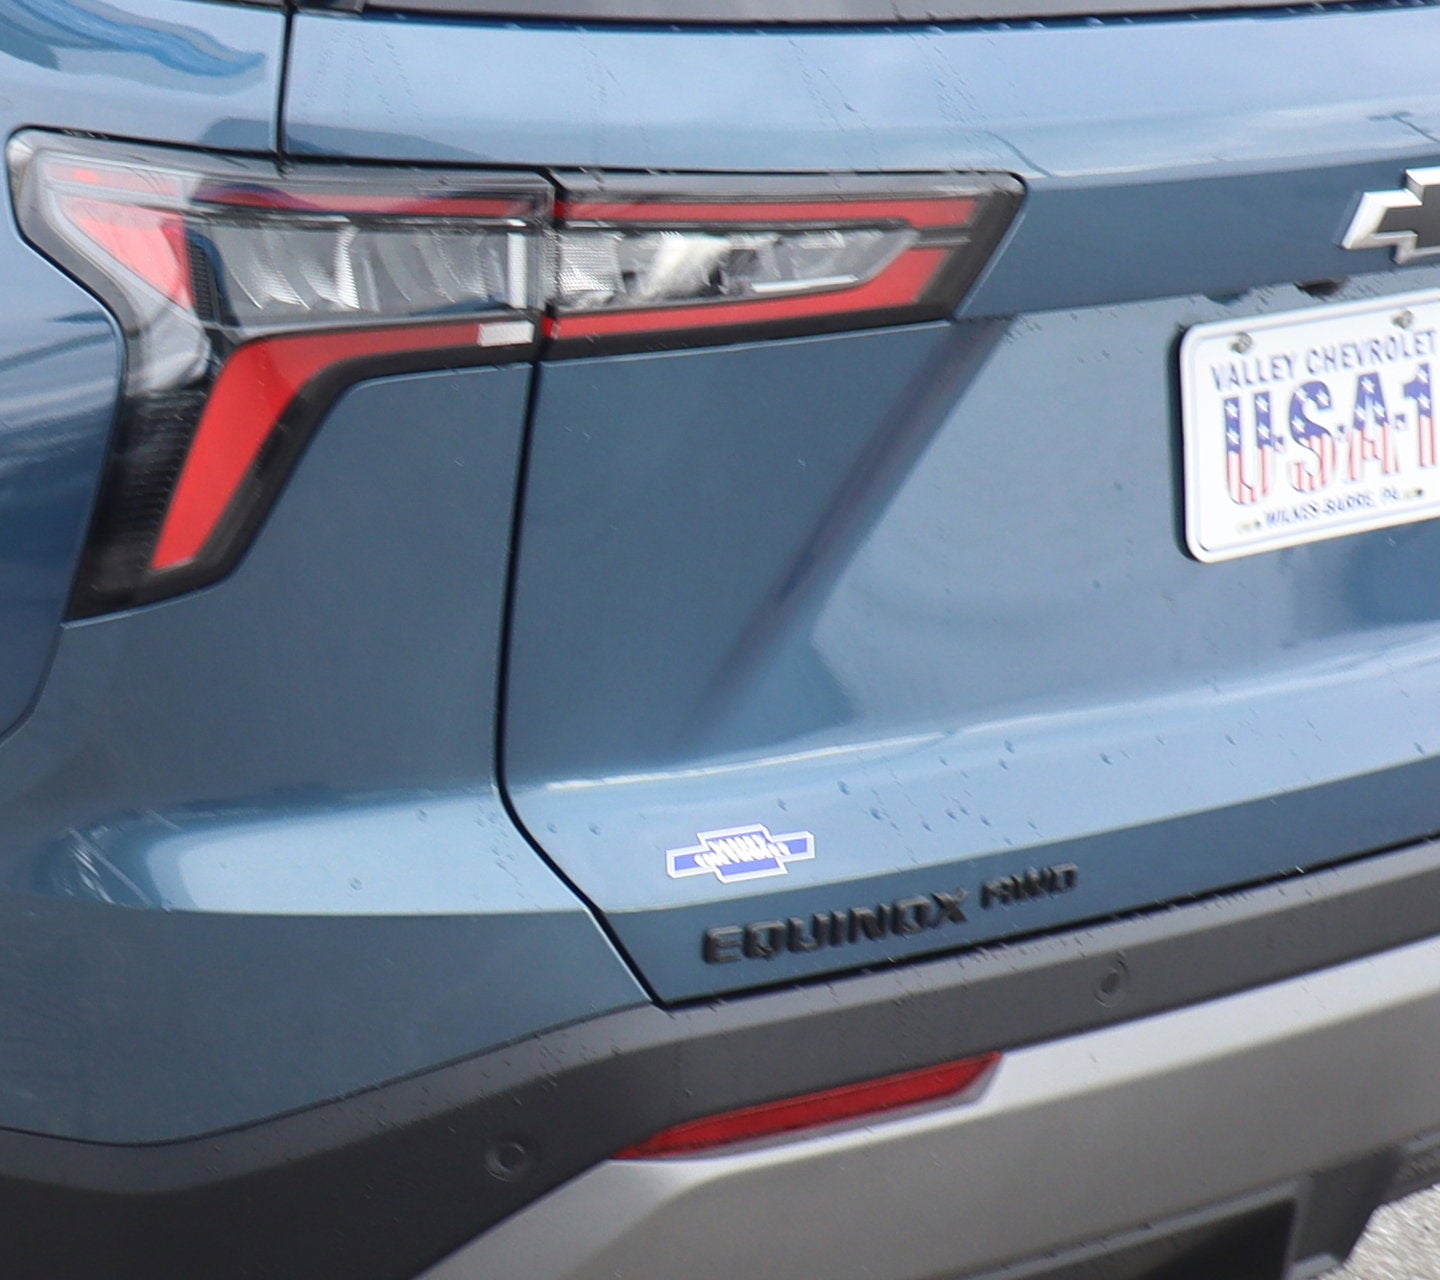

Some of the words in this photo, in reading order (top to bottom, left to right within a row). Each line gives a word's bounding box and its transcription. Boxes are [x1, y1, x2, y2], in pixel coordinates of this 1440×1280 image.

[1210, 352, 1295, 392] VALLEY
[1305, 328, 1436, 375] CHEVROLET
[701, 884, 970, 964] EQUINOX
[978, 862, 1079, 910] AWD
